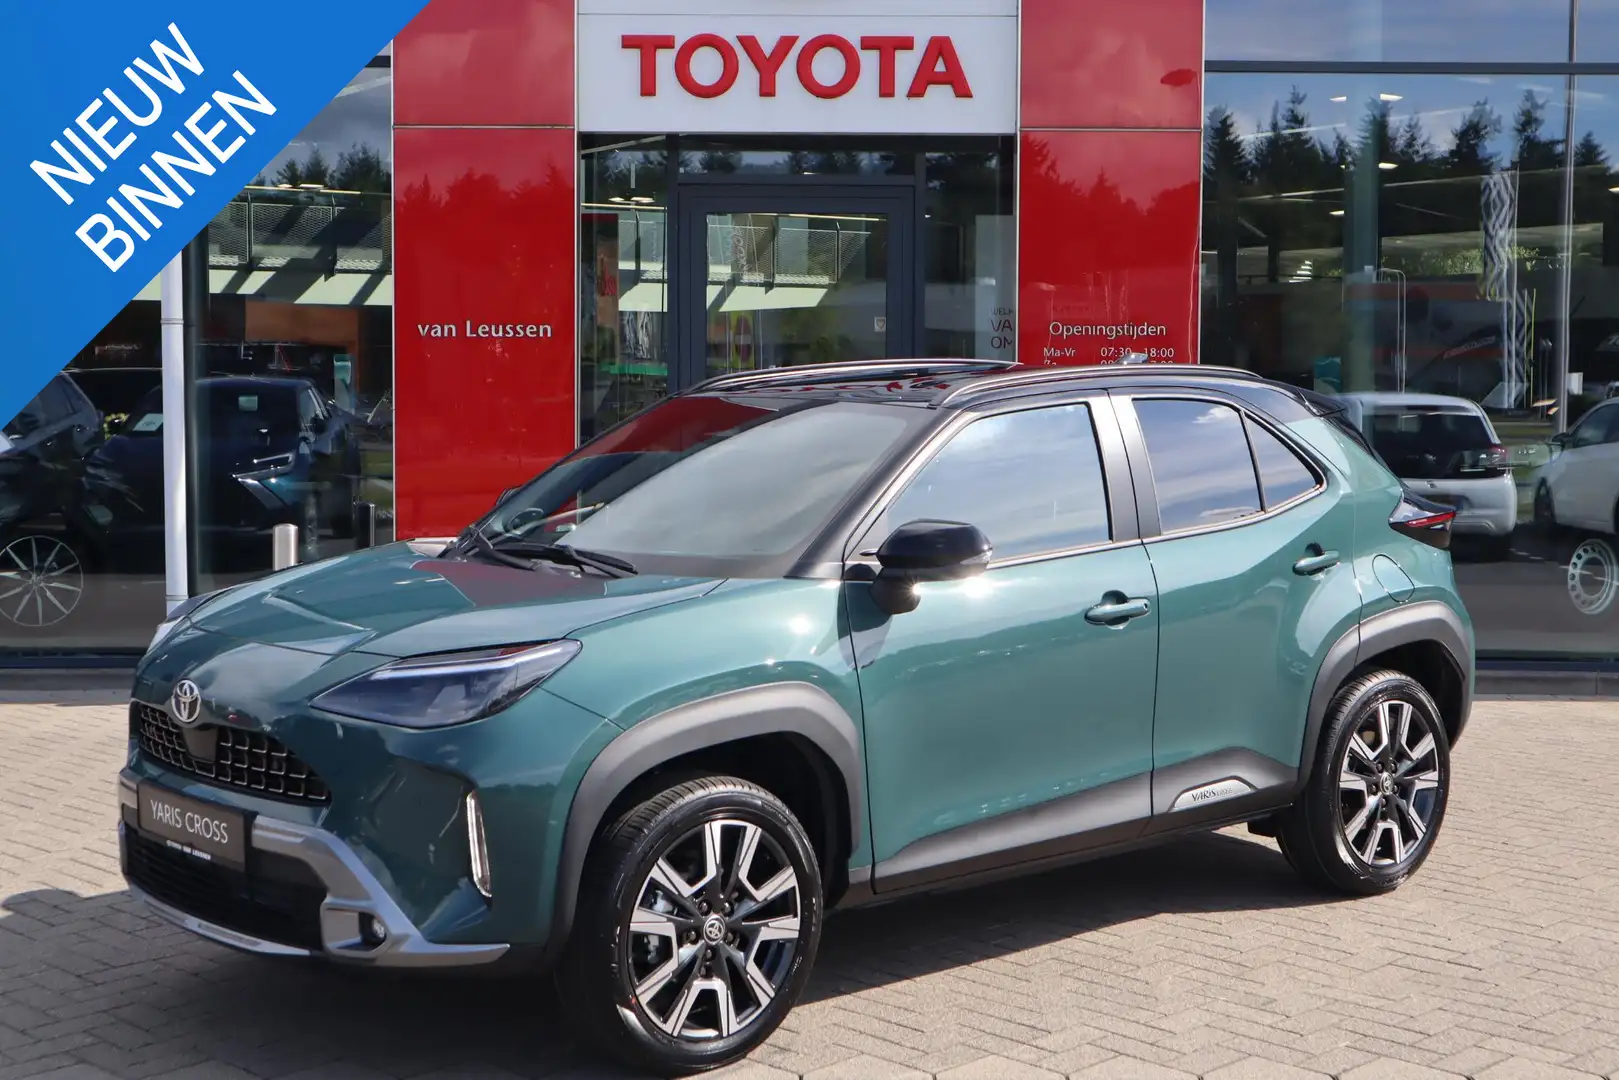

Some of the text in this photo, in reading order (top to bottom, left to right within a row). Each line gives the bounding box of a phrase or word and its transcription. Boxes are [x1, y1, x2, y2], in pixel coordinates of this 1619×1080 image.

[621, 33, 973, 98] TOYOTA
[417, 320, 552, 337] van Leussen
[1049, 321, 1167, 340] Openingstijden
[1043, 347, 1076, 357] Ma-Vr
[1191, 788, 1216, 802] YARIS
[150, 799, 228, 844] YARIS CROSS
